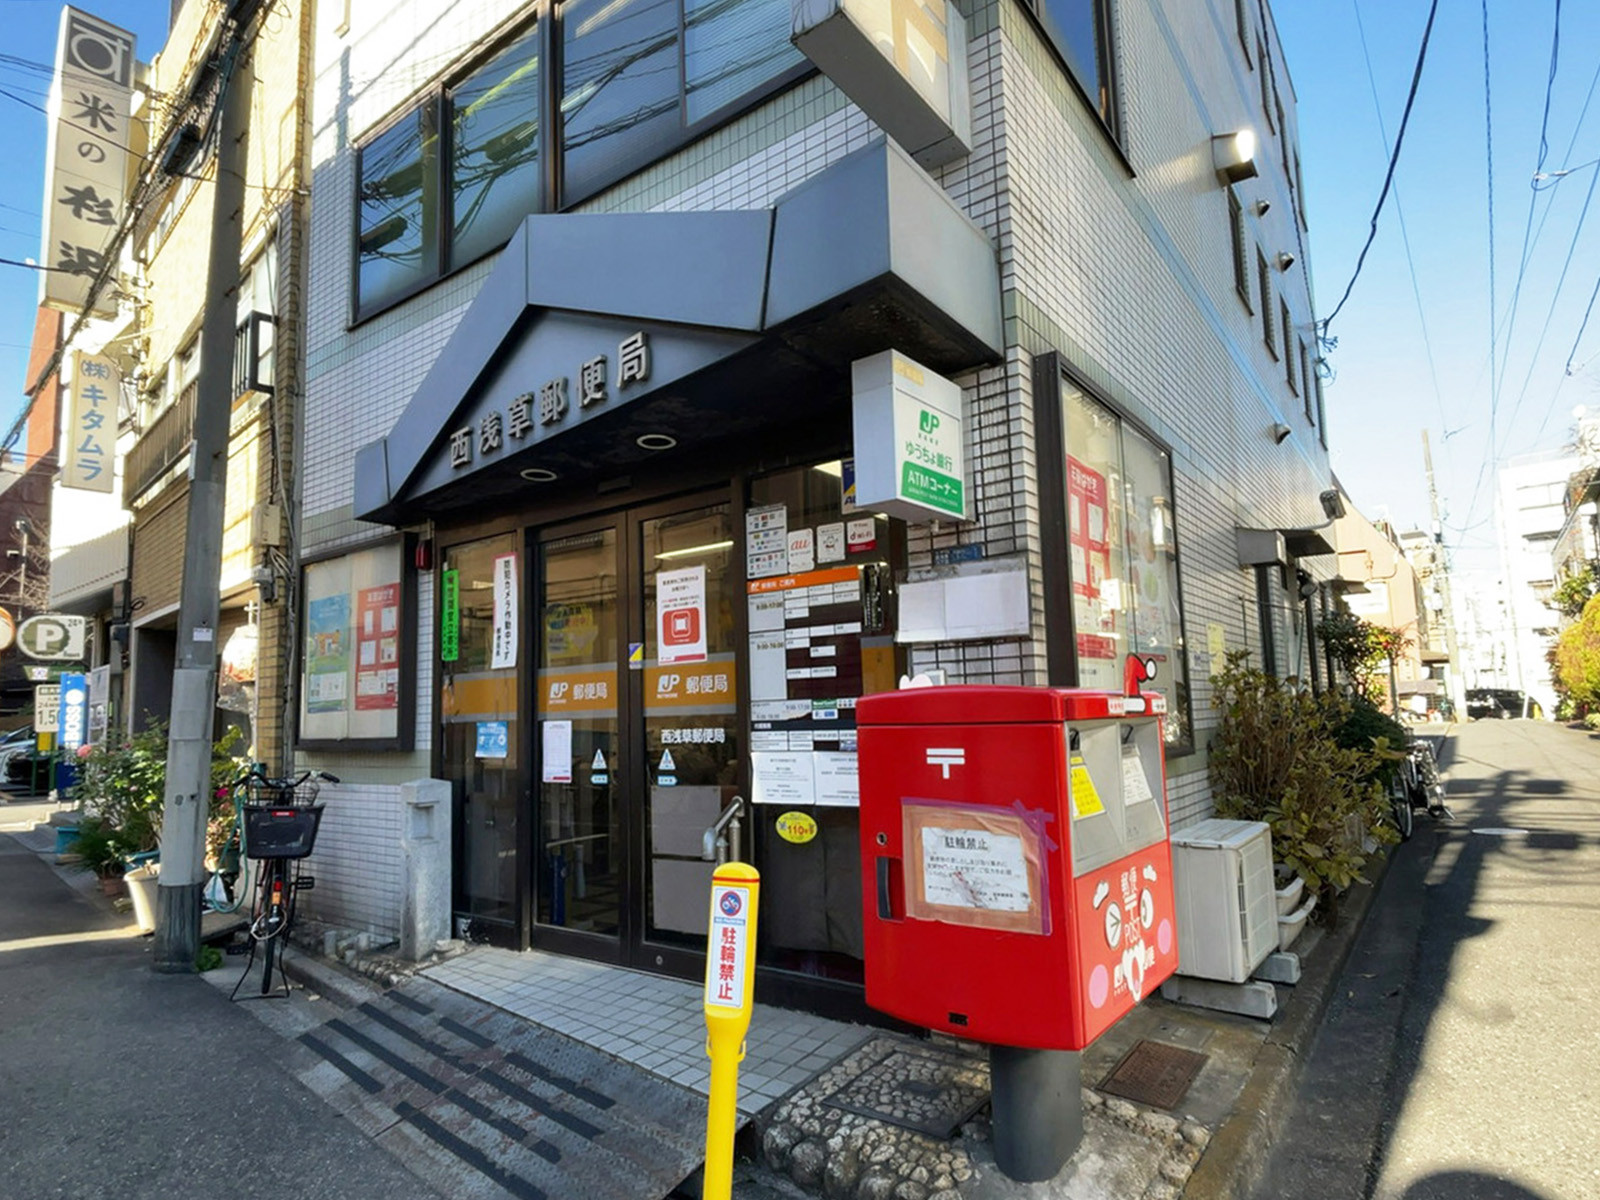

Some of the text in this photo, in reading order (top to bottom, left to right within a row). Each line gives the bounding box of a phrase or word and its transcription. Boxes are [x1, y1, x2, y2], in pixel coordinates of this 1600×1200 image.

[450, 331, 648, 468] 西浅草郵便局
[905, 441, 952, 472] ゆうちょ銀行
[907, 470, 958, 495] ATMコーナー
[36, 624, 63, 651] P
[573, 682, 607, 699] 郵便局
[686, 674, 728, 693] 郵便局
[661, 728, 725, 743] 西浅草郵便局
[945, 836, 988, 850] 駐輪禁止
[718, 927, 737, 1000] 駐輪禁止
